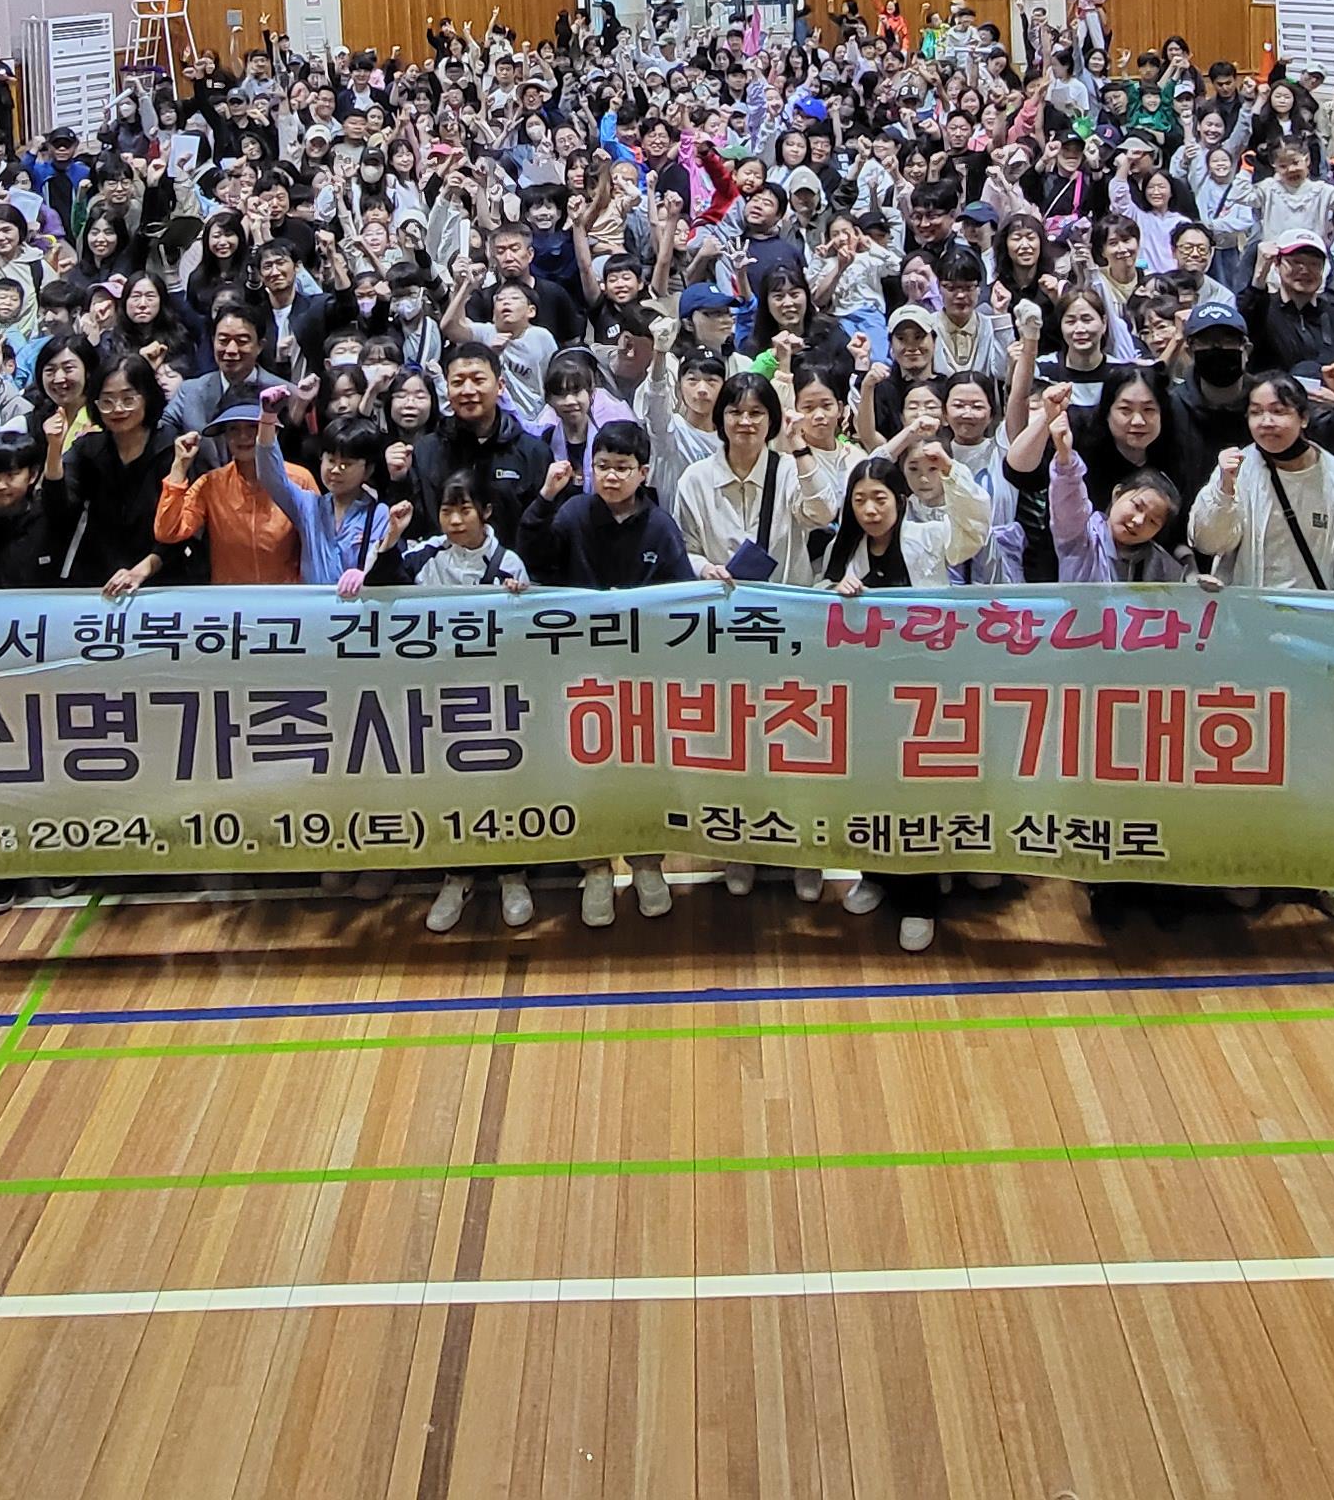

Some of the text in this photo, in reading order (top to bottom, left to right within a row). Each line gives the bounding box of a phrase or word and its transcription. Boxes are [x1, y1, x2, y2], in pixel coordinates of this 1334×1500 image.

[73, 611, 307, 663] 행복하고
[327, 609, 503, 660] 건강한
[525, 607, 641, 656] 우리
[665, 605, 802, 656] 가족,
[826, 600, 1218, 655] 사랑합니다!
[566, 678, 850, 775] 해반천
[893, 684, 1286, 785] 걷기대회
[31, 817, 167, 852] 2024.
[184, 812, 257, 851] 10.
[273, 810, 426, 851] 19.(토)
[443, 805, 576, 841] 14:00
[701, 805, 799, 845] 장소
[847, 812, 993, 855] 해반천
[1011, 814, 1167, 861] 산책로
